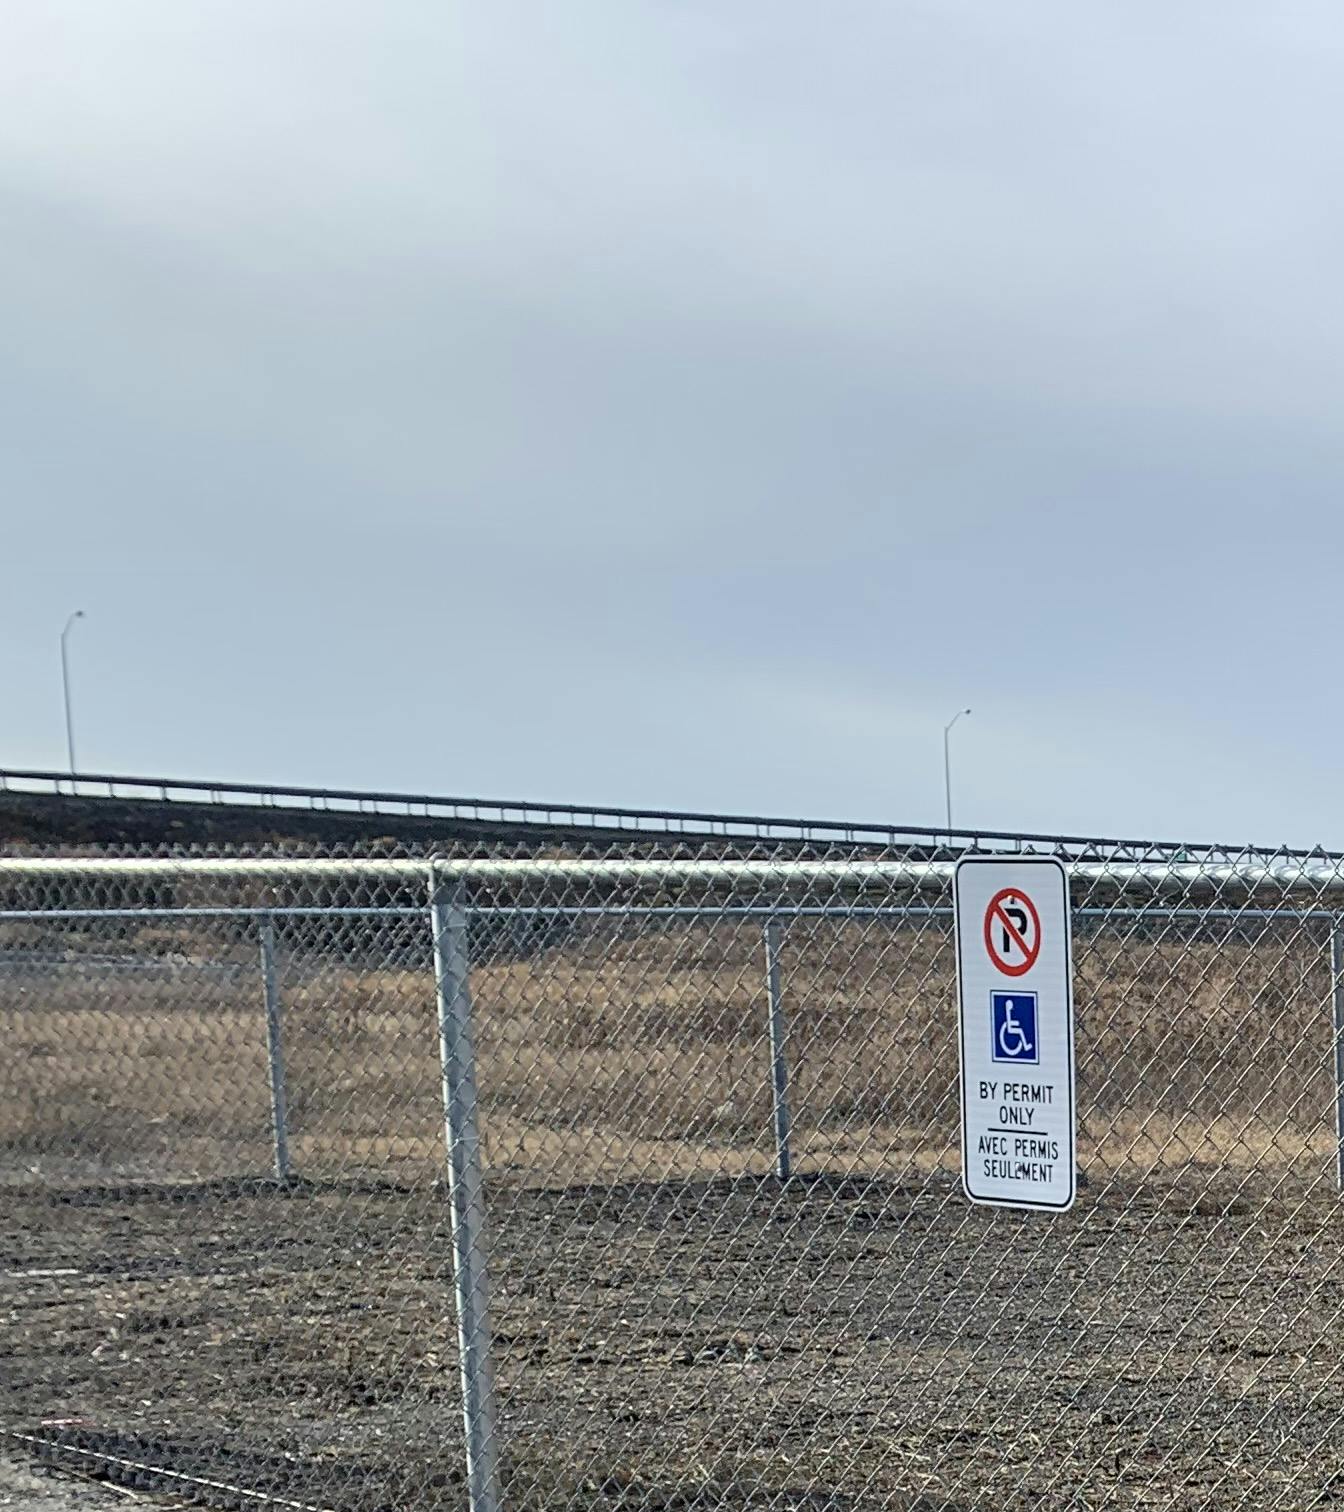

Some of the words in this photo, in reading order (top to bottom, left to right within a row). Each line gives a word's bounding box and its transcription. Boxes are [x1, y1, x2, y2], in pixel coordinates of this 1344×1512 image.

[979, 1081, 998, 1100] BY
[1003, 1082, 1054, 1104] PERMIT
[999, 1105, 1035, 1126] ONLY
[978, 1135, 1008, 1156] AVEC
[1014, 1138, 1059, 1161] PERMIS
